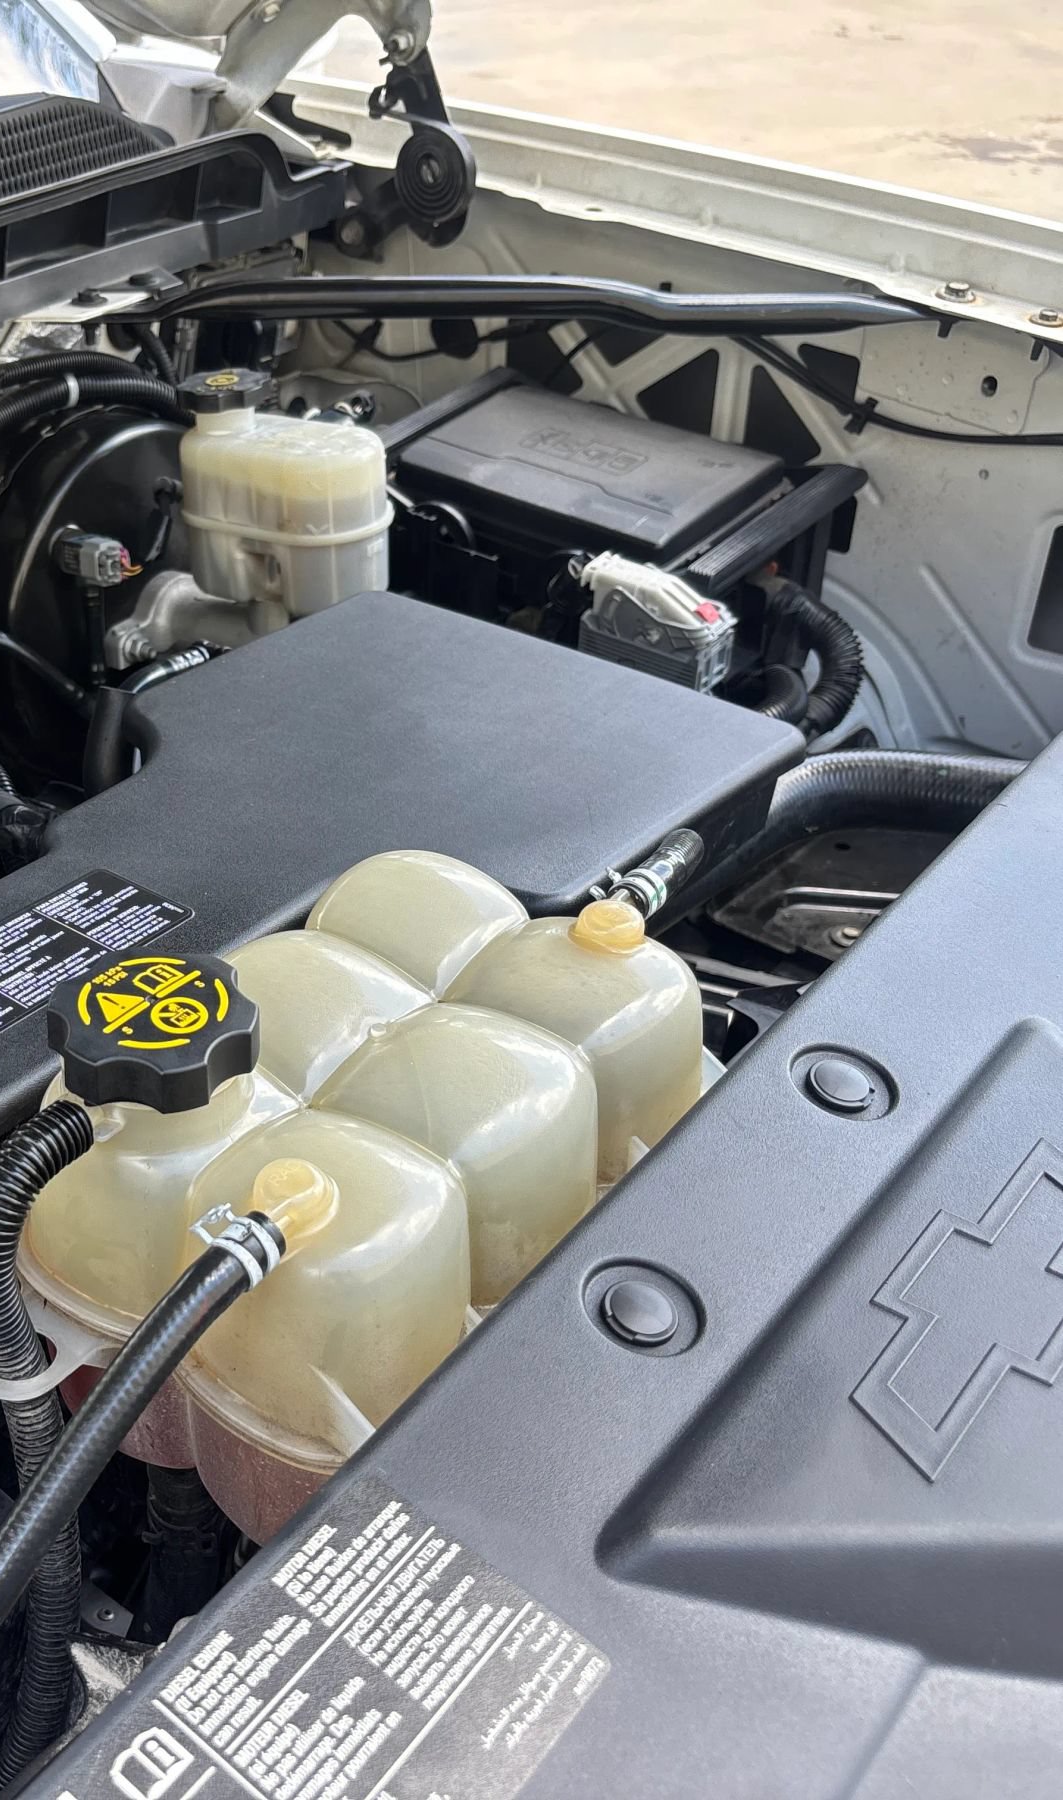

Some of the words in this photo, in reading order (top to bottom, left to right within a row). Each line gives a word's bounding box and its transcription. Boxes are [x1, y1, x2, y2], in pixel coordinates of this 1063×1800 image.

[271, 1552, 308, 1586] MOTOR
[301, 1524, 337, 1555] DIESEL
[295, 1591, 315, 1607] No
[310, 1574, 330, 1593] use
[324, 1547, 356, 1577] fluidos
[351, 1535, 367, 1550] de
[362, 1501, 401, 1538] arranque.
[305, 1546, 337, 1573] tiene)
[307, 1601, 327, 1619] Se
[321, 1570, 355, 1606] pueden
[350, 1536, 386, 1575] producir
[382, 1512, 409, 1539] daños
[365, 1566, 380, 1581] en
[375, 1556, 389, 1569] el
[383, 1533, 412, 1561] motor.
[343, 1584, 399, 1647] ДИЗЕЛЬНЫЙ
[394, 1538, 444, 1590] ДВИГАТЕЛЬ
[160, 1666, 200, 1702] DIESEL
[192, 1630, 233, 1668] ENGINE
[185, 1706, 206, 1727] Do
[200, 1689, 225, 1709] not
[216, 1672, 238, 1697] use
[233, 1639, 272, 1676] starting
[262, 1614, 296, 1641] fluids.
[185, 1651, 236, 1700] Equipped)
[198, 1684, 250, 1736] Immediate
[245, 1650, 279, 1686] engine
[270, 1618, 312, 1656] damage
[212, 1724, 235, 1747] can
[229, 1696, 262, 1727] result.
[233, 1721, 277, 1767] MOTEUR
[270, 1689, 309, 1726] DIESEL
[259, 1772, 279, 1791] Ne
[274, 1753, 297, 1778] pas
[291, 1719, 324, 1756] utiliser
[320, 1706, 337, 1727] de
[330, 1676, 365, 1710] liquide
[329, 1714, 357, 1737] Des
[385, 1711, 402, 1728] en
